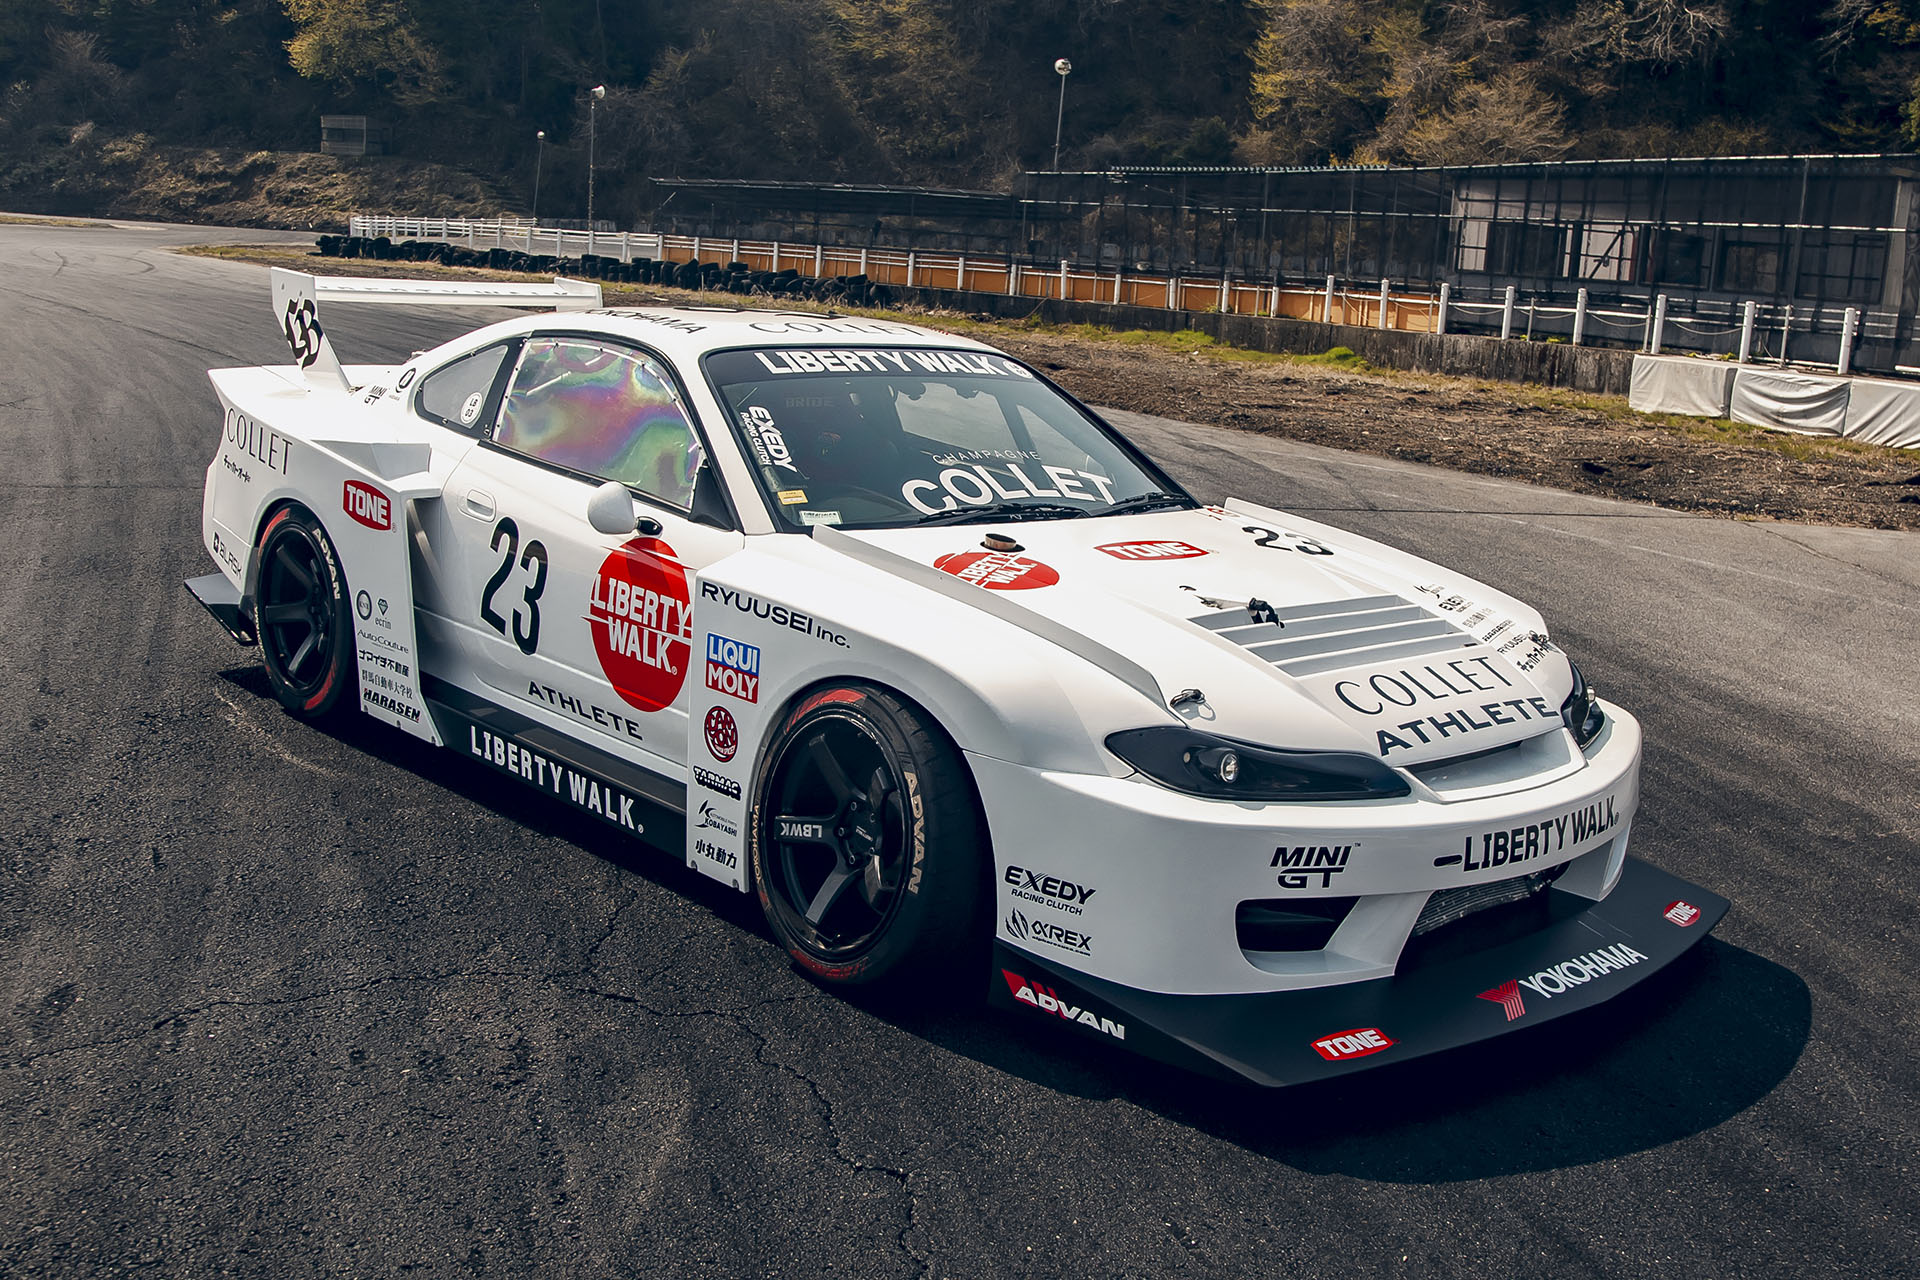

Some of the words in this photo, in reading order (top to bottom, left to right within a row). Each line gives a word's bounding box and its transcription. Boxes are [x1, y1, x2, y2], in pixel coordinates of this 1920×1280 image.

[749, 321, 925, 337] COLLET
[754, 351, 912, 374] LIBERTY
[904, 351, 1009, 376] WALK
[226, 408, 293, 475] COLLET
[740, 411, 759, 441] RACING
[752, 438, 772, 466] CLUTCH
[748, 406, 798, 473] EXEDY
[932, 449, 1041, 465] CHAMPAGNE
[347, 484, 388, 527] TONE
[901, 463, 1116, 515] COLLET
[1101, 542, 1203, 559] TONE
[1241, 526, 1334, 556] 23
[312, 527, 340, 599] ADVAN
[481, 517, 549, 656] 23
[590, 573, 692, 639] LIBERTY
[375, 617, 392, 629] ecrin
[701, 581, 813, 635] RYUUSEI
[816, 625, 851, 649] Inc.
[607, 616, 673, 673] WALK
[708, 635, 759, 673] LIQUI
[707, 663, 758, 700] MOLY
[1335, 656, 1512, 715] COLLET
[363, 688, 421, 721] HARASEN
[528, 680, 643, 741] ATHLETE
[1376, 697, 1560, 757] ATHLETE
[470, 725, 563, 793] LIBERTY
[568, 770, 635, 830] WALK
[694, 766, 741, 800] TARMAC
[704, 818, 737, 837] KOBAYASHI
[752, 804, 761, 884] YOKOHAMA
[780, 821, 823, 839] LBWK
[903, 771, 926, 894] ADVAN
[1463, 814, 1568, 872] LIBERTY
[1572, 795, 1615, 843] WALK
[695, 839, 737, 869] 小丸動力
[1270, 846, 1352, 868] MINI
[1004, 865, 1097, 905] EXEDY
[1277, 867, 1345, 889] GT
[1011, 888, 1045, 904] RACING
[1046, 900, 1083, 916] CLUTCH
[1665, 901, 1698, 924] TONE
[1518, 942, 1649, 999] YOKOHAMA
[1016, 985, 1125, 1040] ADVAN
[1317, 1029, 1388, 1057] TONE
